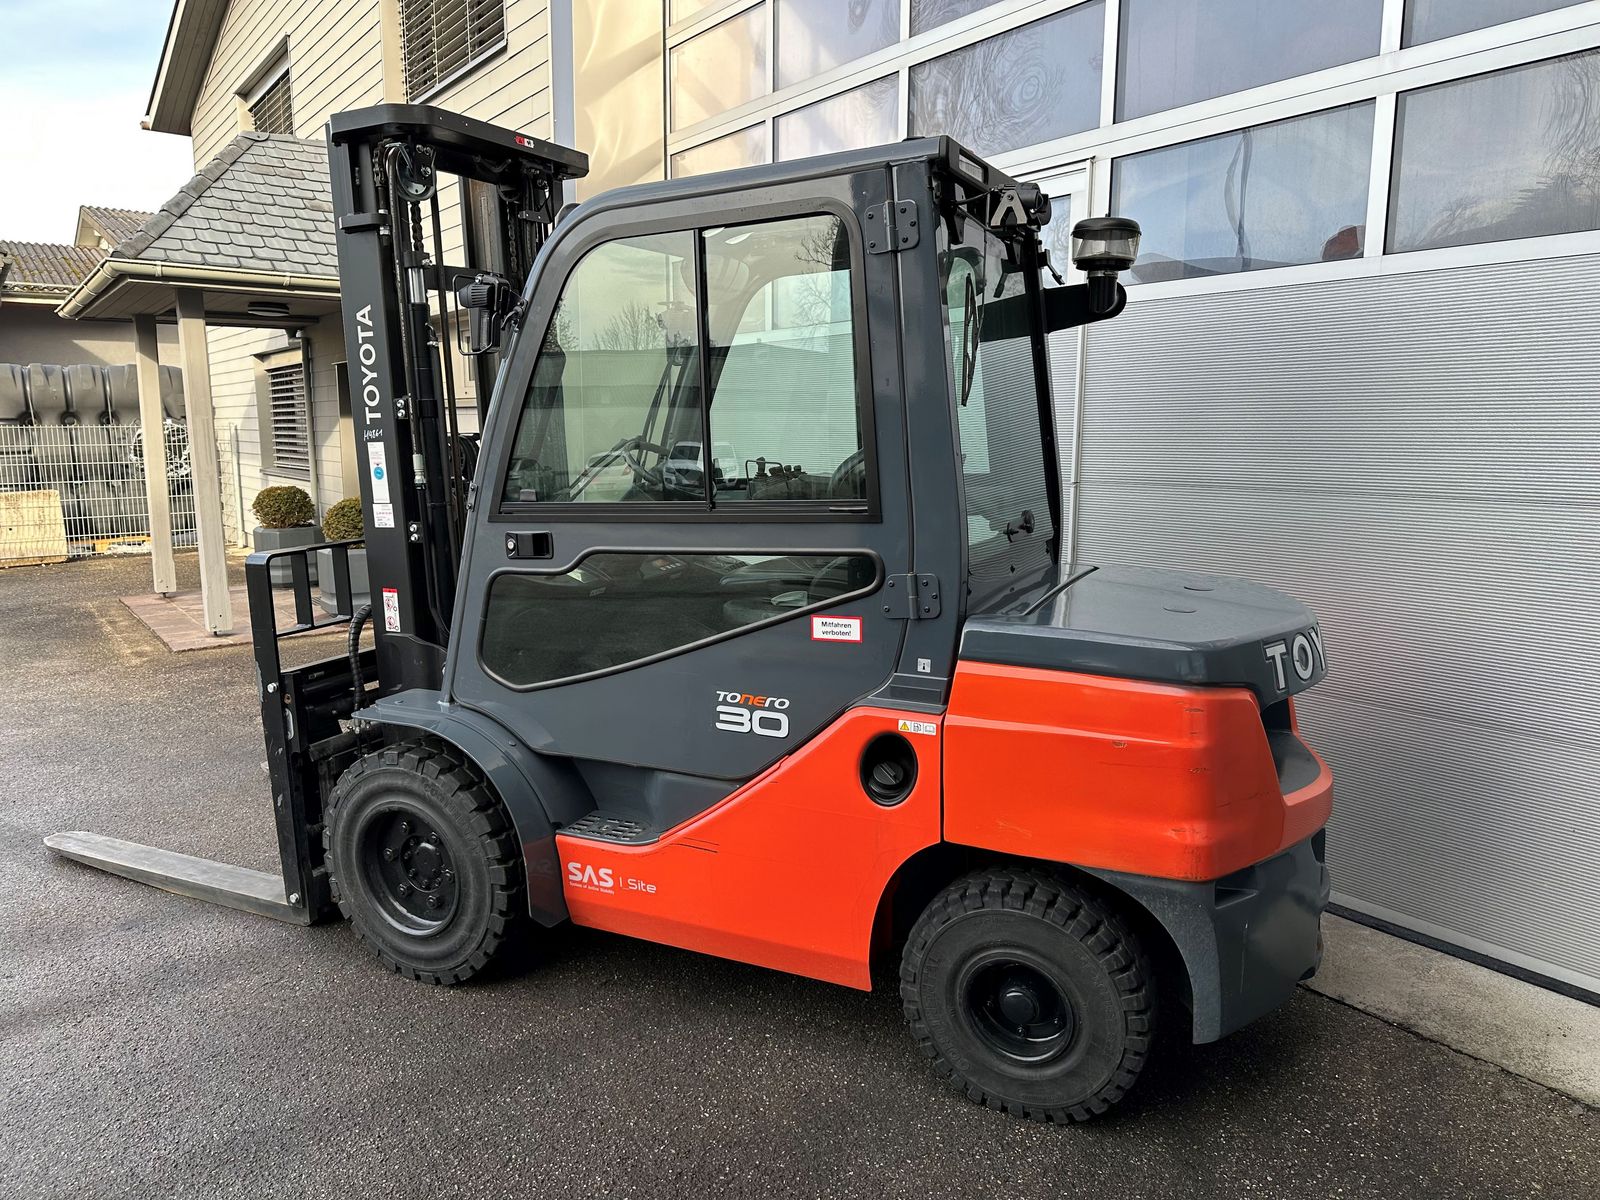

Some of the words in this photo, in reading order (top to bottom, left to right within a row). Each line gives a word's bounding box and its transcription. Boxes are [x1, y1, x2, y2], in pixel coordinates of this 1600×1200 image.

[356, 304, 382, 425] TOYOTA
[821, 621, 852, 629] Mitfahren
[715, 705, 789, 738] 30
[567, 861, 614, 888] SAS
